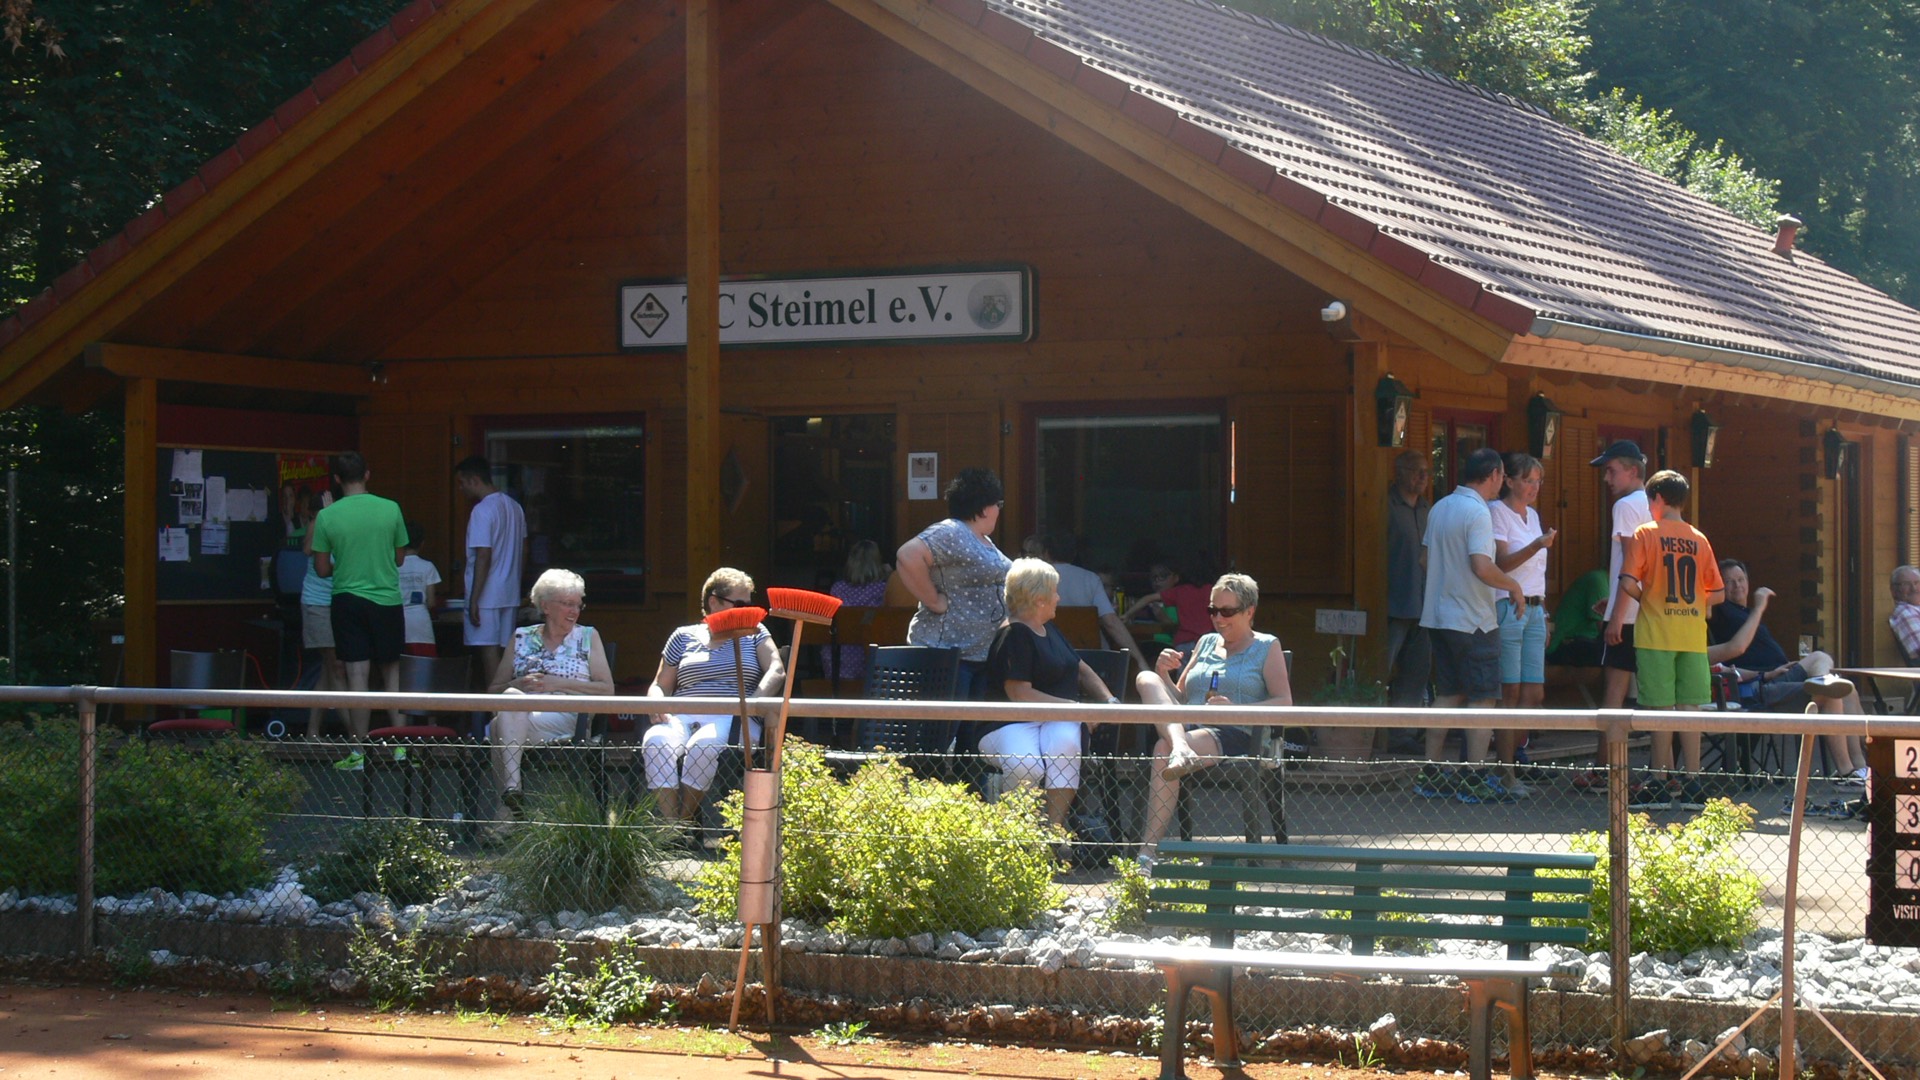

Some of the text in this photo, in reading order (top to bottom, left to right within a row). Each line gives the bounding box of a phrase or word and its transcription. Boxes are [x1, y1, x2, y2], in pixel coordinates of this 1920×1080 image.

[749, 290, 877, 328] Steimel
[889, 285, 952, 324] e.V.
[1660, 536, 1698, 555] MESSI
[1663, 553, 1696, 604] 10
[1906, 746, 1918, 772] 2
[1907, 802, 1919, 828] 3
